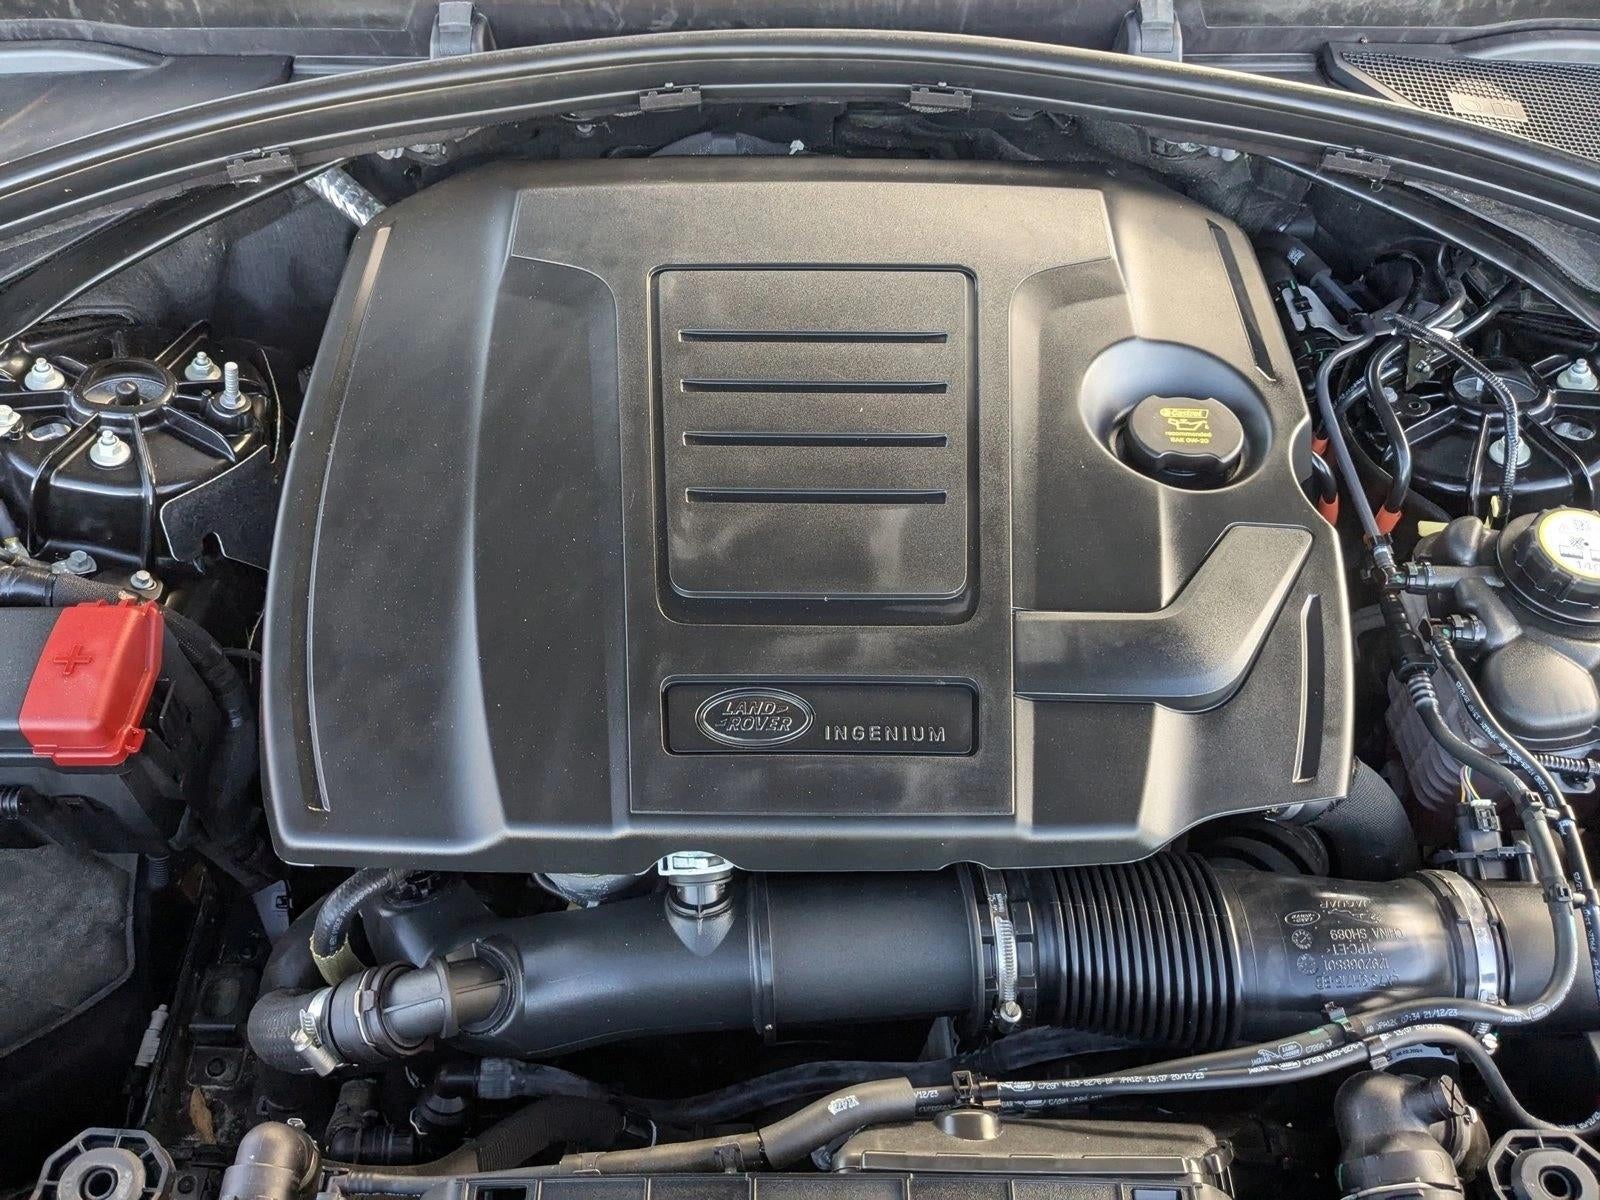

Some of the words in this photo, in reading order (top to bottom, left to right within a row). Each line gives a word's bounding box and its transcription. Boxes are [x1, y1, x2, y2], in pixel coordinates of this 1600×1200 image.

[722, 701, 777, 715] LAND
[726, 716, 793, 731] ROVER
[824, 725, 947, 742] INGENIUM
[1423, 1008, 1459, 1019] 21/12/23
